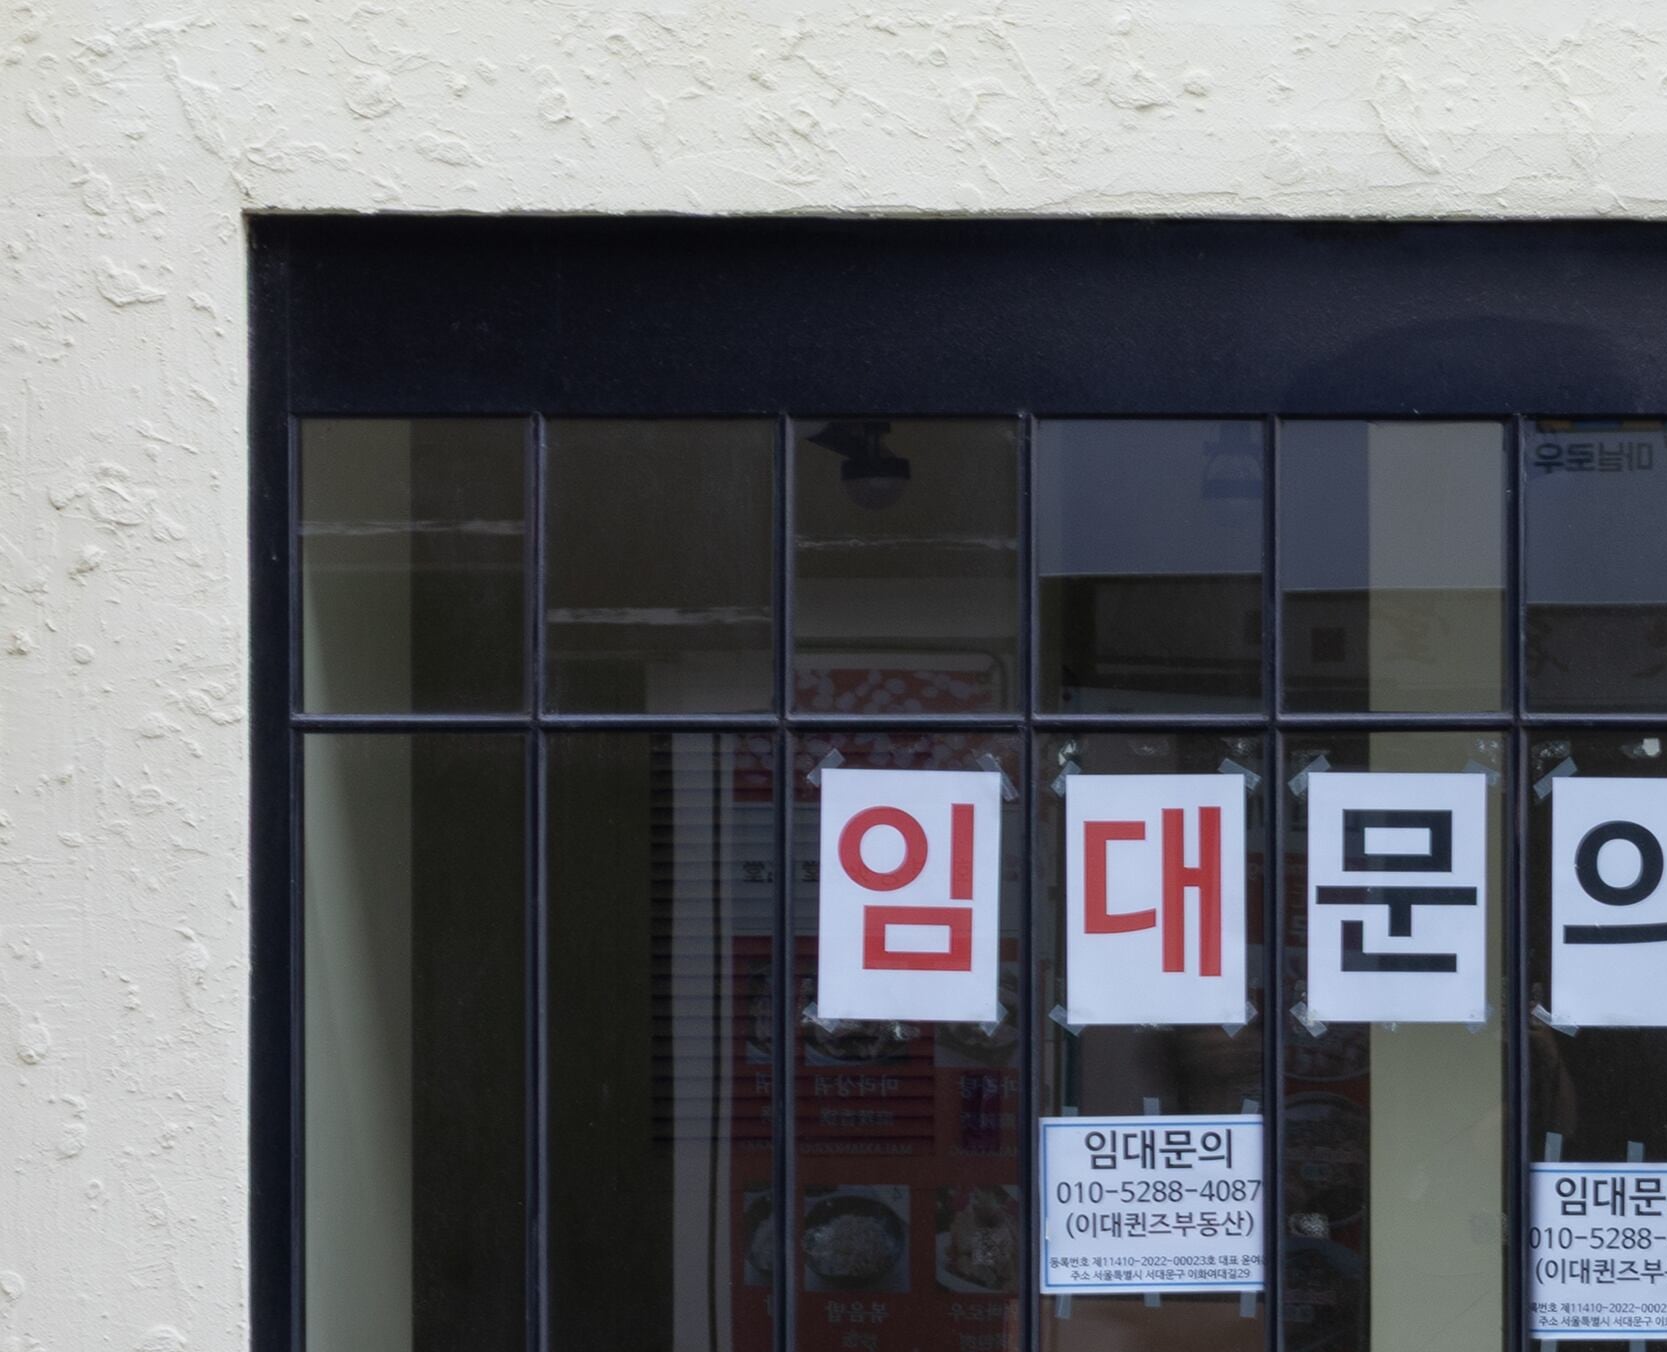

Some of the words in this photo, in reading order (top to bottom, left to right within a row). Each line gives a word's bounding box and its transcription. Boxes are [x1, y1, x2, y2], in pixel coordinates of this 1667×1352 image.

[1085, 1129, 1232, 1170] 임대문의
[1057, 1179, 1262, 1203] 010-5288-4087
[1066, 1210, 1254, 1239] (이대퀸즈부동산)
[1050, 1256, 1089, 1269] 등록번호
[1218, 1254, 1238, 1266] 대표
[1071, 1269, 1090, 1281] 주소
[1094, 1268, 1142, 1281] 서울특별시
[1145, 1268, 1186, 1280] 서대문구
[1539, 1315, 1558, 1327] 주소
[1561, 1315, 1611, 1328] 서울특별시
[1613, 1315, 1653, 1327] 서대문구
